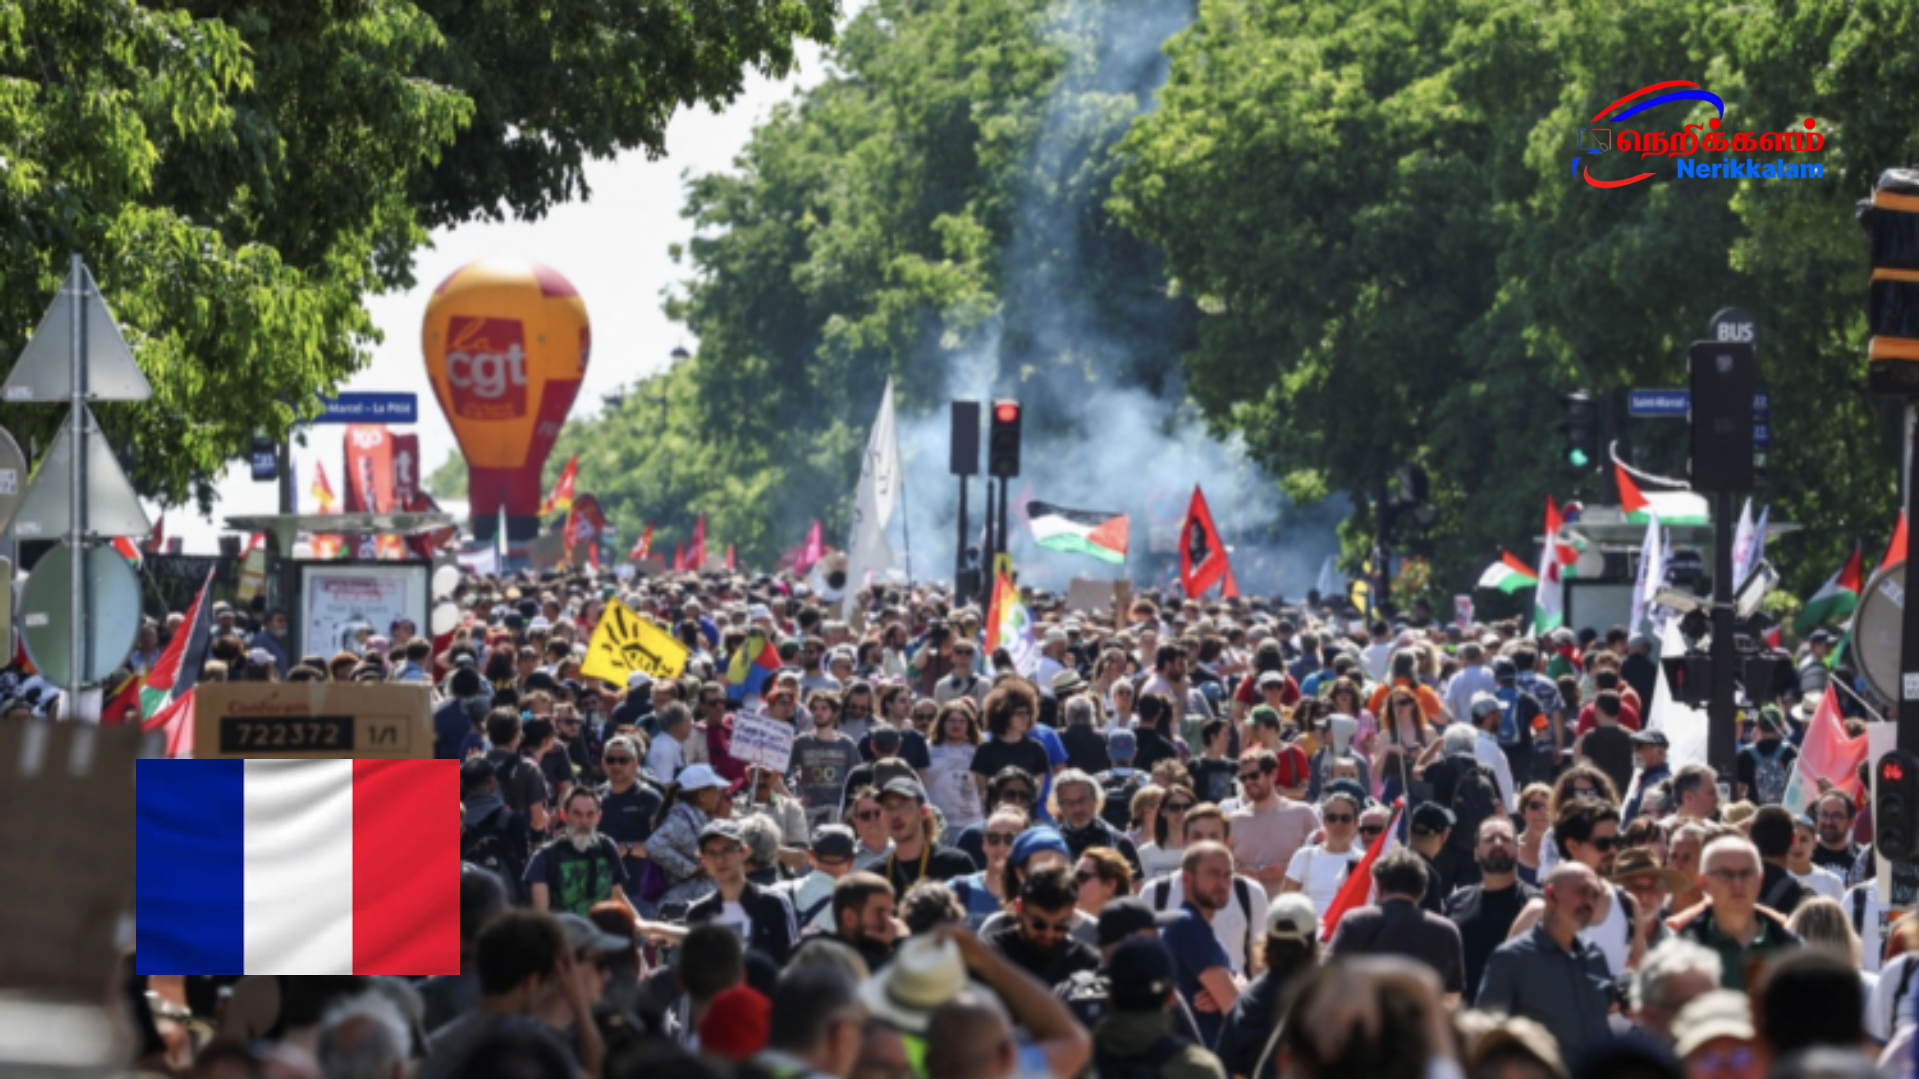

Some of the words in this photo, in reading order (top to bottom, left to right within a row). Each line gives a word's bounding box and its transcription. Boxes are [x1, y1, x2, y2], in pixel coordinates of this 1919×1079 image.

[1717, 322, 1754, 341] BUS
[446, 342, 527, 399] cgt
[237, 723, 340, 745] 722372
[367, 724, 398, 745] 1/1
